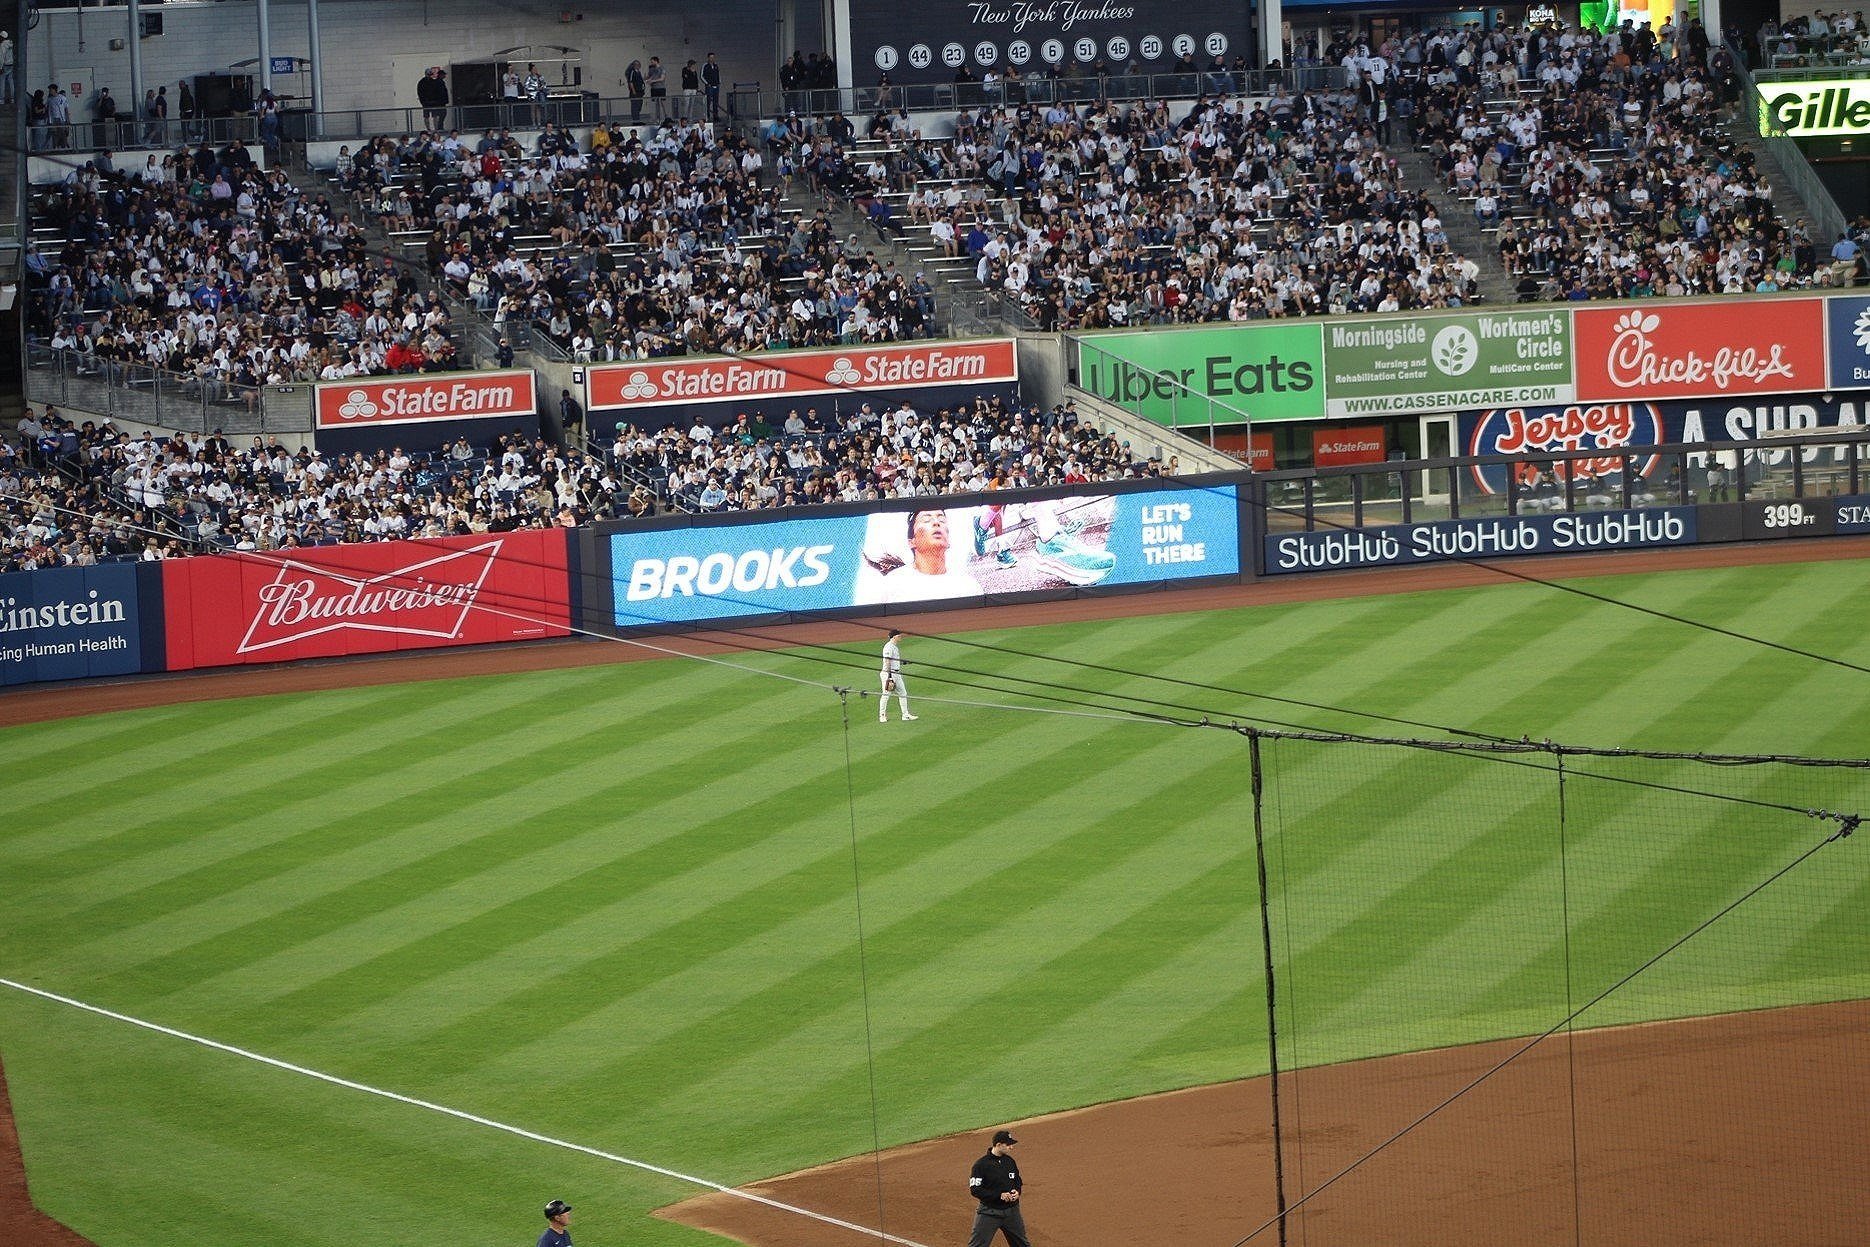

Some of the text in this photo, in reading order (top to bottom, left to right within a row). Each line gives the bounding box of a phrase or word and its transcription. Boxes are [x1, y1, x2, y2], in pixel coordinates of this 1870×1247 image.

[967, 0, 1135, 34] New York Yankees
[883, 51, 890, 65] 1
[911, 50, 928, 63] 44
[945, 49, 962, 62] 23
[977, 47, 993, 60] 49
[1010, 46, 1027, 59] 42
[1049, 45, 1057, 58] 6
[1079, 44, 1093, 56] 51
[1110, 42, 1127, 55] 46
[1143, 41, 1159, 54] 20
[1209, 38, 1224, 51] 21
[1332, 324, 1426, 350] Morningside
[1478, 314, 1564, 340] Workmen's
[1516, 336, 1562, 360] Circle
[1607, 328, 1795, 389] Chick-fil-A
[1335, 370, 1428, 384] Rehabilitation Center
[1375, 358, 1427, 371] Nursing and
[1489, 362, 1564, 375] MultiCare Center
[1089, 355, 1315, 403] Uber Eats
[1345, 387, 1556, 413] WWW.CASSENACARE.COM
[1496, 402, 1635, 453] Jersey
[1682, 409, 1707, 470] A
[1141, 502, 1193, 525] LET'S
[1763, 503, 1815, 528] 399 FT
[1141, 524, 1184, 545] RUN
[1278, 511, 1684, 569] StubHub StubHub StubHub
[1142, 542, 1206, 566] THERE
[627, 543, 834, 603] BROOKS
[258, 576, 477, 626] Budweiser
[25, 643, 76, 658] Human
[79, 635, 127, 653] Health
